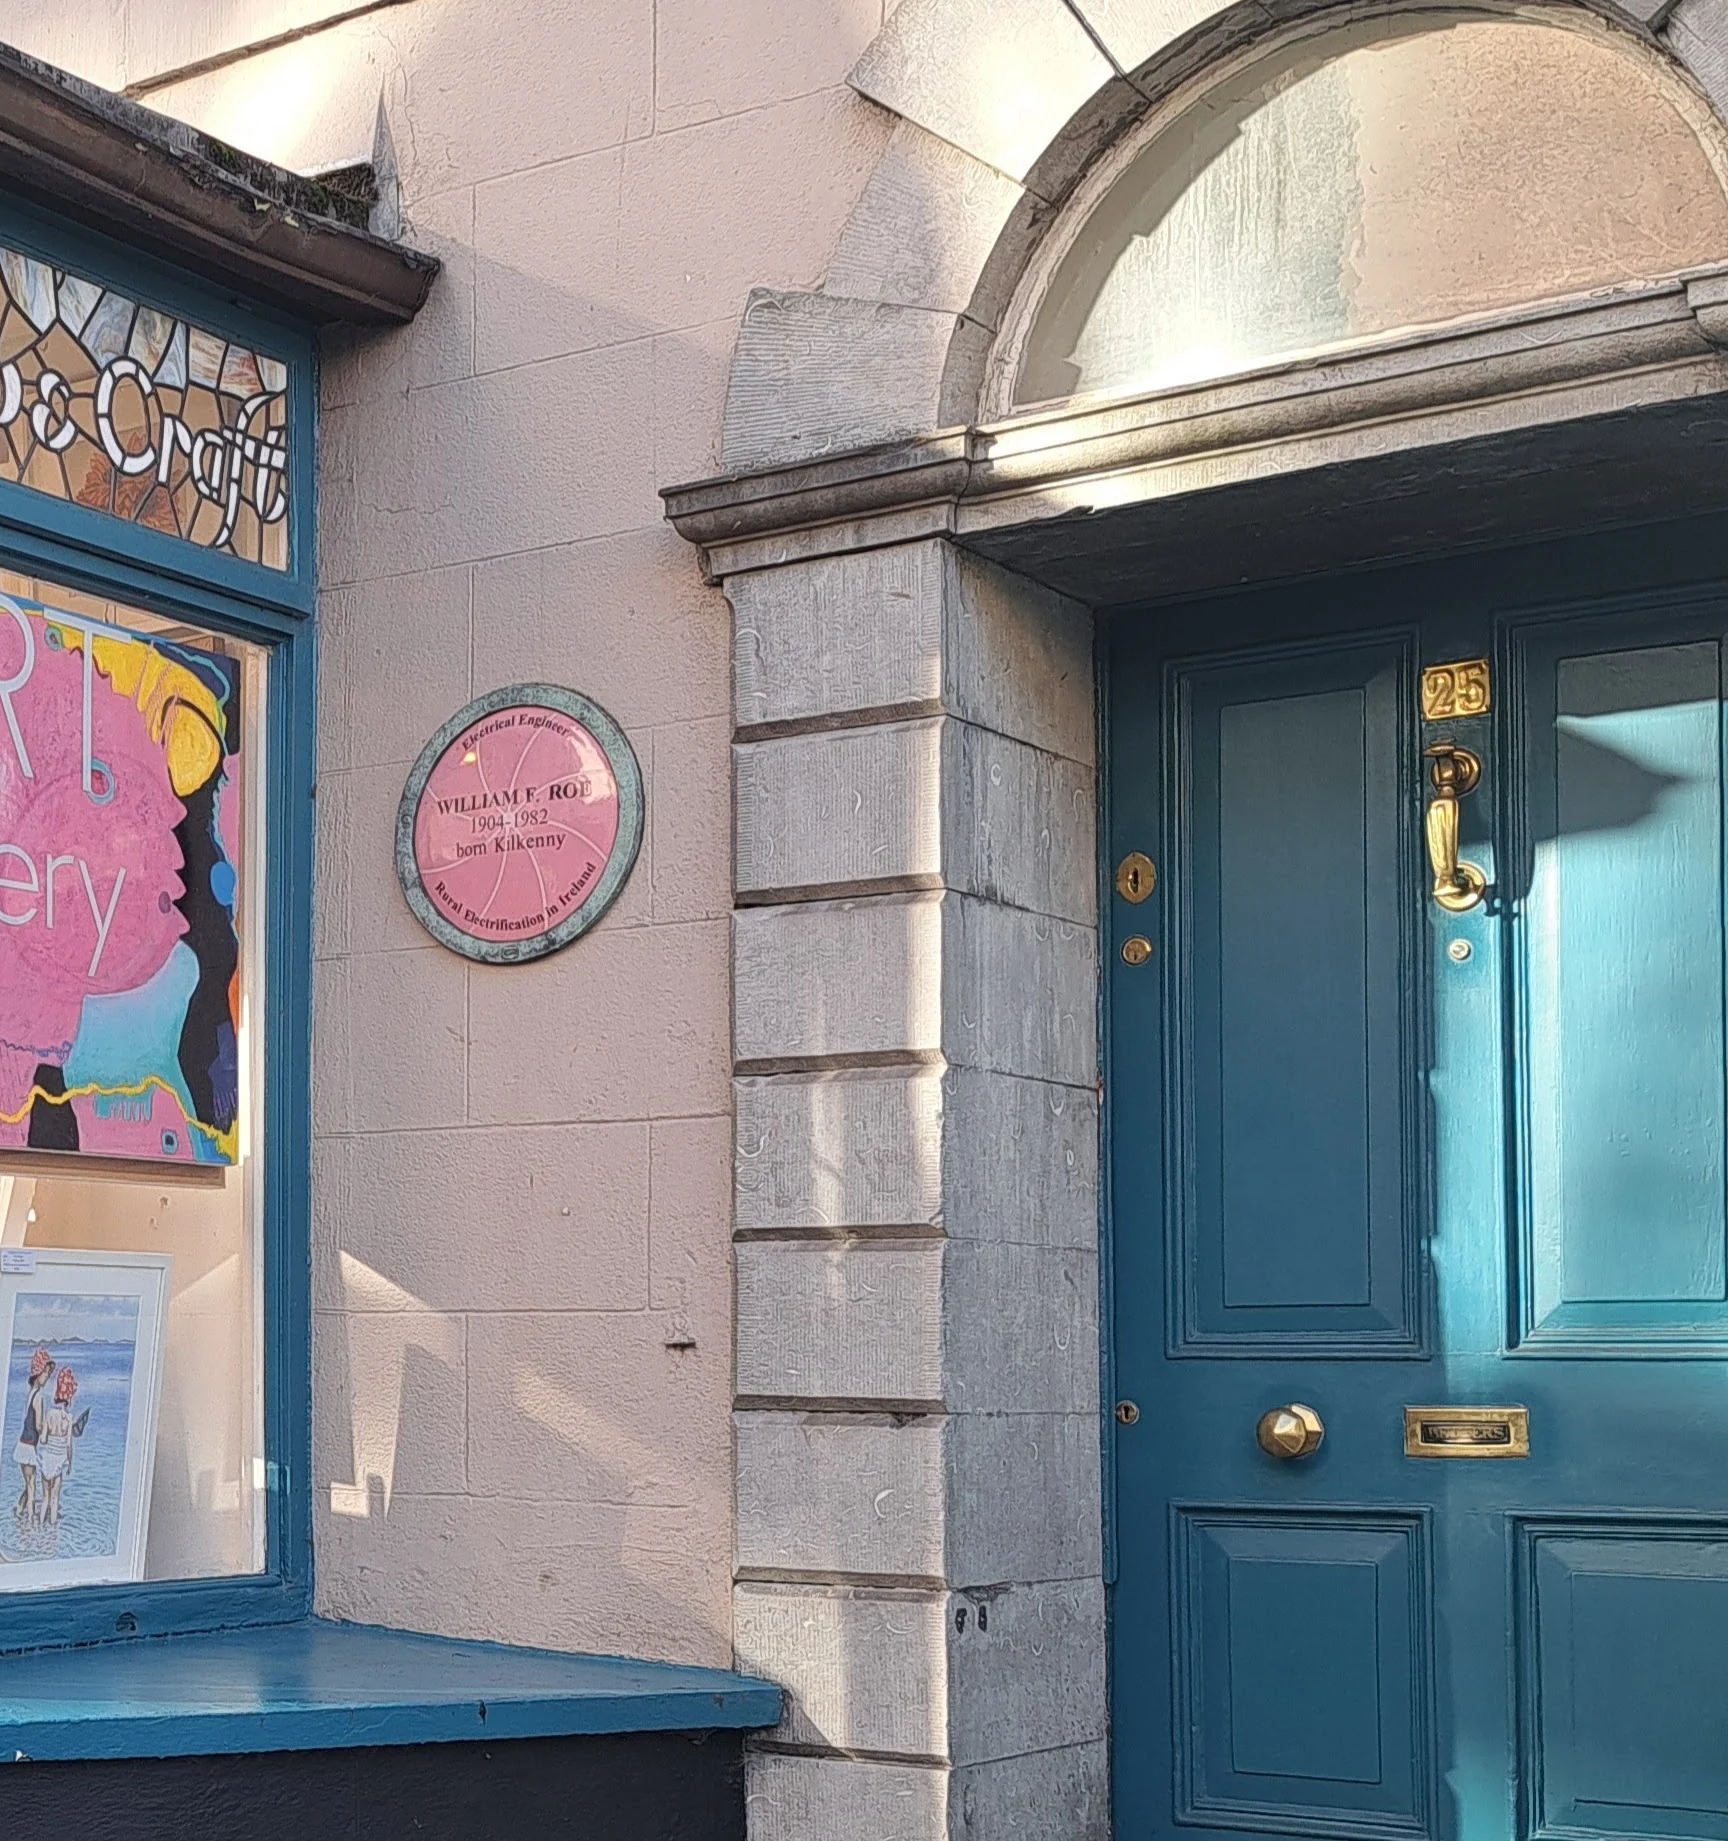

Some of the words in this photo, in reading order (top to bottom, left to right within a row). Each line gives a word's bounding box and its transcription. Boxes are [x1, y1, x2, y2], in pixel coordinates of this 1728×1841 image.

[1425, 663, 1487, 717] 25
[462, 715, 515, 751] Electrical
[519, 713, 570, 737] Engineer
[436, 790, 519, 816] WILLIAM
[525, 787, 541, 804] F.
[549, 779, 593, 801] ROE
[471, 808, 549, 834] 1904-1982
[456, 841, 487, 858] born
[494, 832, 567, 854] Kilkenny
[434, 880, 462, 914] Rural
[464, 909, 545, 932] Electrification
[545, 904, 560, 918] in
[559, 861, 597, 907] Ireland
